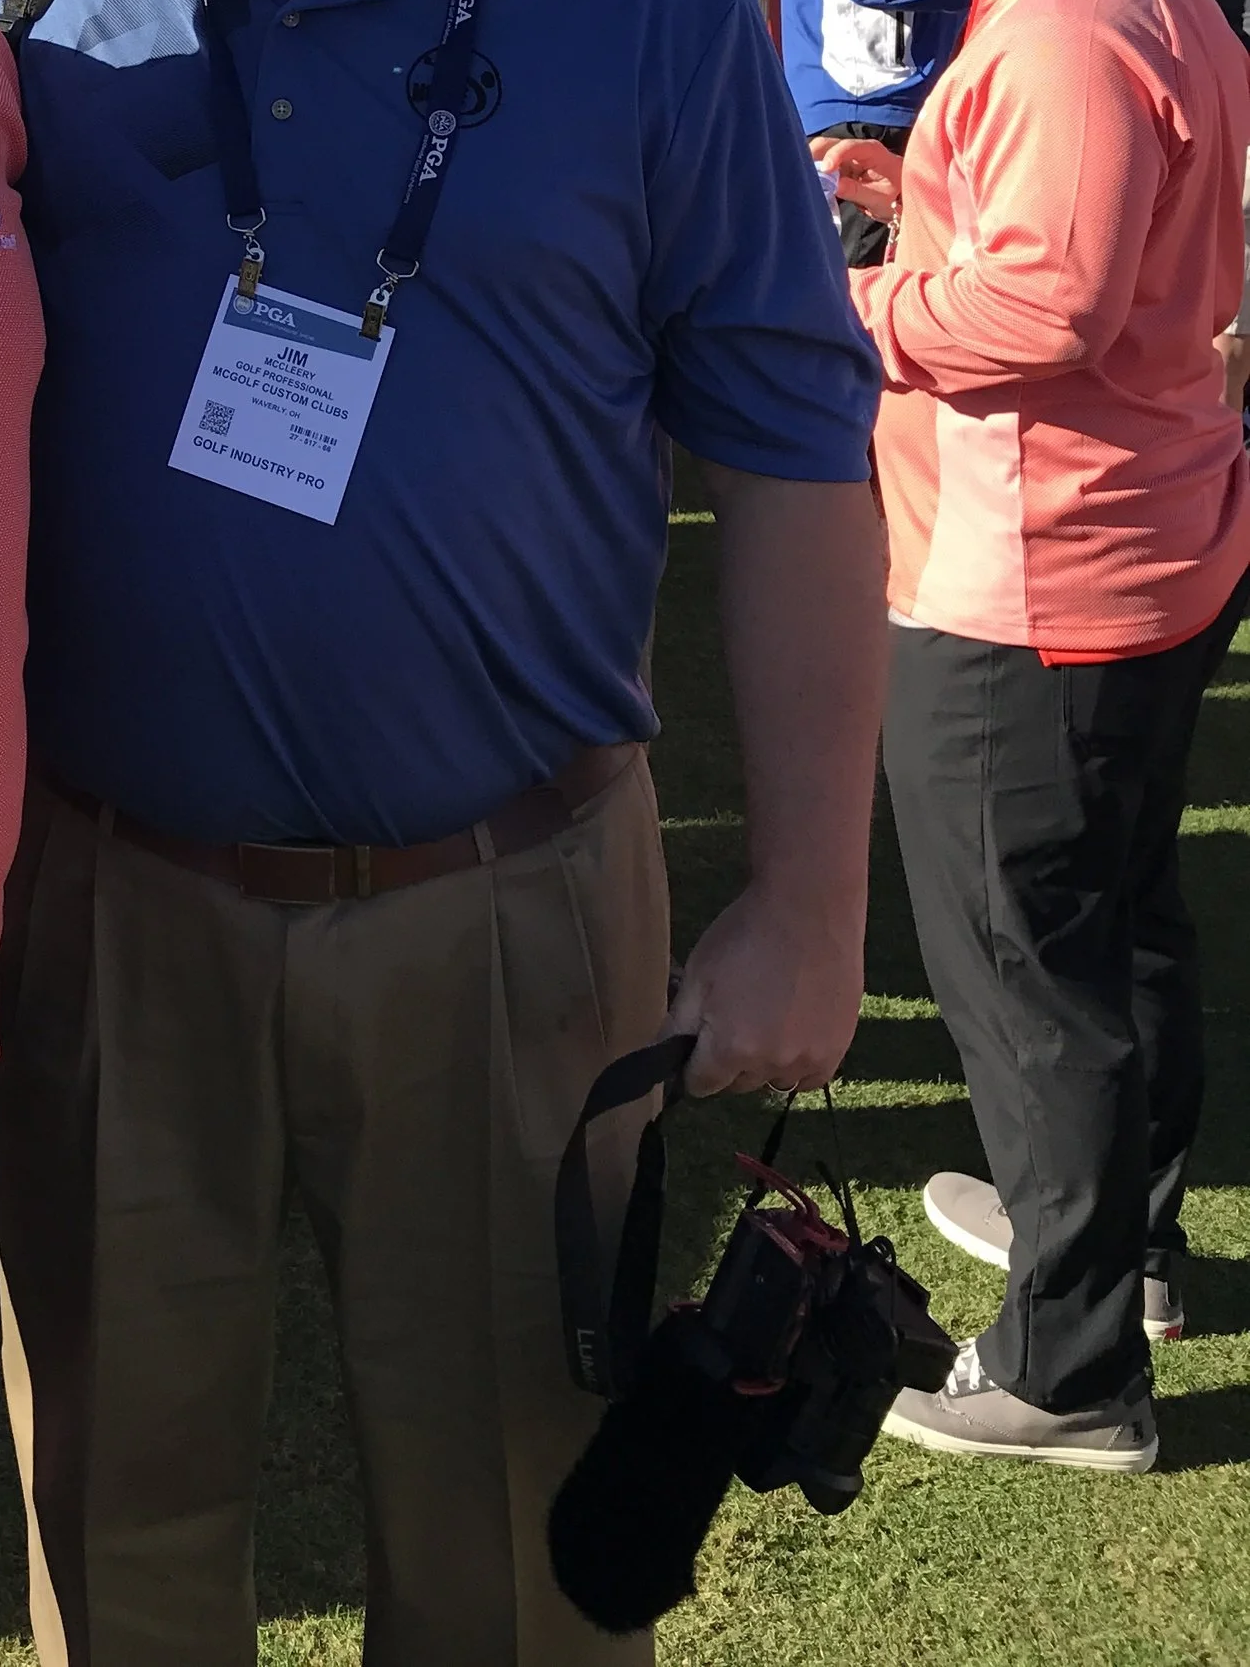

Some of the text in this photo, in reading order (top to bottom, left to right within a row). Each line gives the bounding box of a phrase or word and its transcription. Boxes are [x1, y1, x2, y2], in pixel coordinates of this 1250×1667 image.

[420, 137, 449, 183] PGA
[254, 301, 296, 328] PGA
[264, 357, 317, 381] MCCLEERY
[277, 346, 309, 368] JIM
[212, 365, 349, 420] MCGOLF CUSTOM CLUBS
[236, 360, 334, 401] GOLF PROFESSIONAL
[251, 397, 301, 420] WAVERLY, OH
[193, 434, 325, 490] GOLF INDUSTRY PRO
